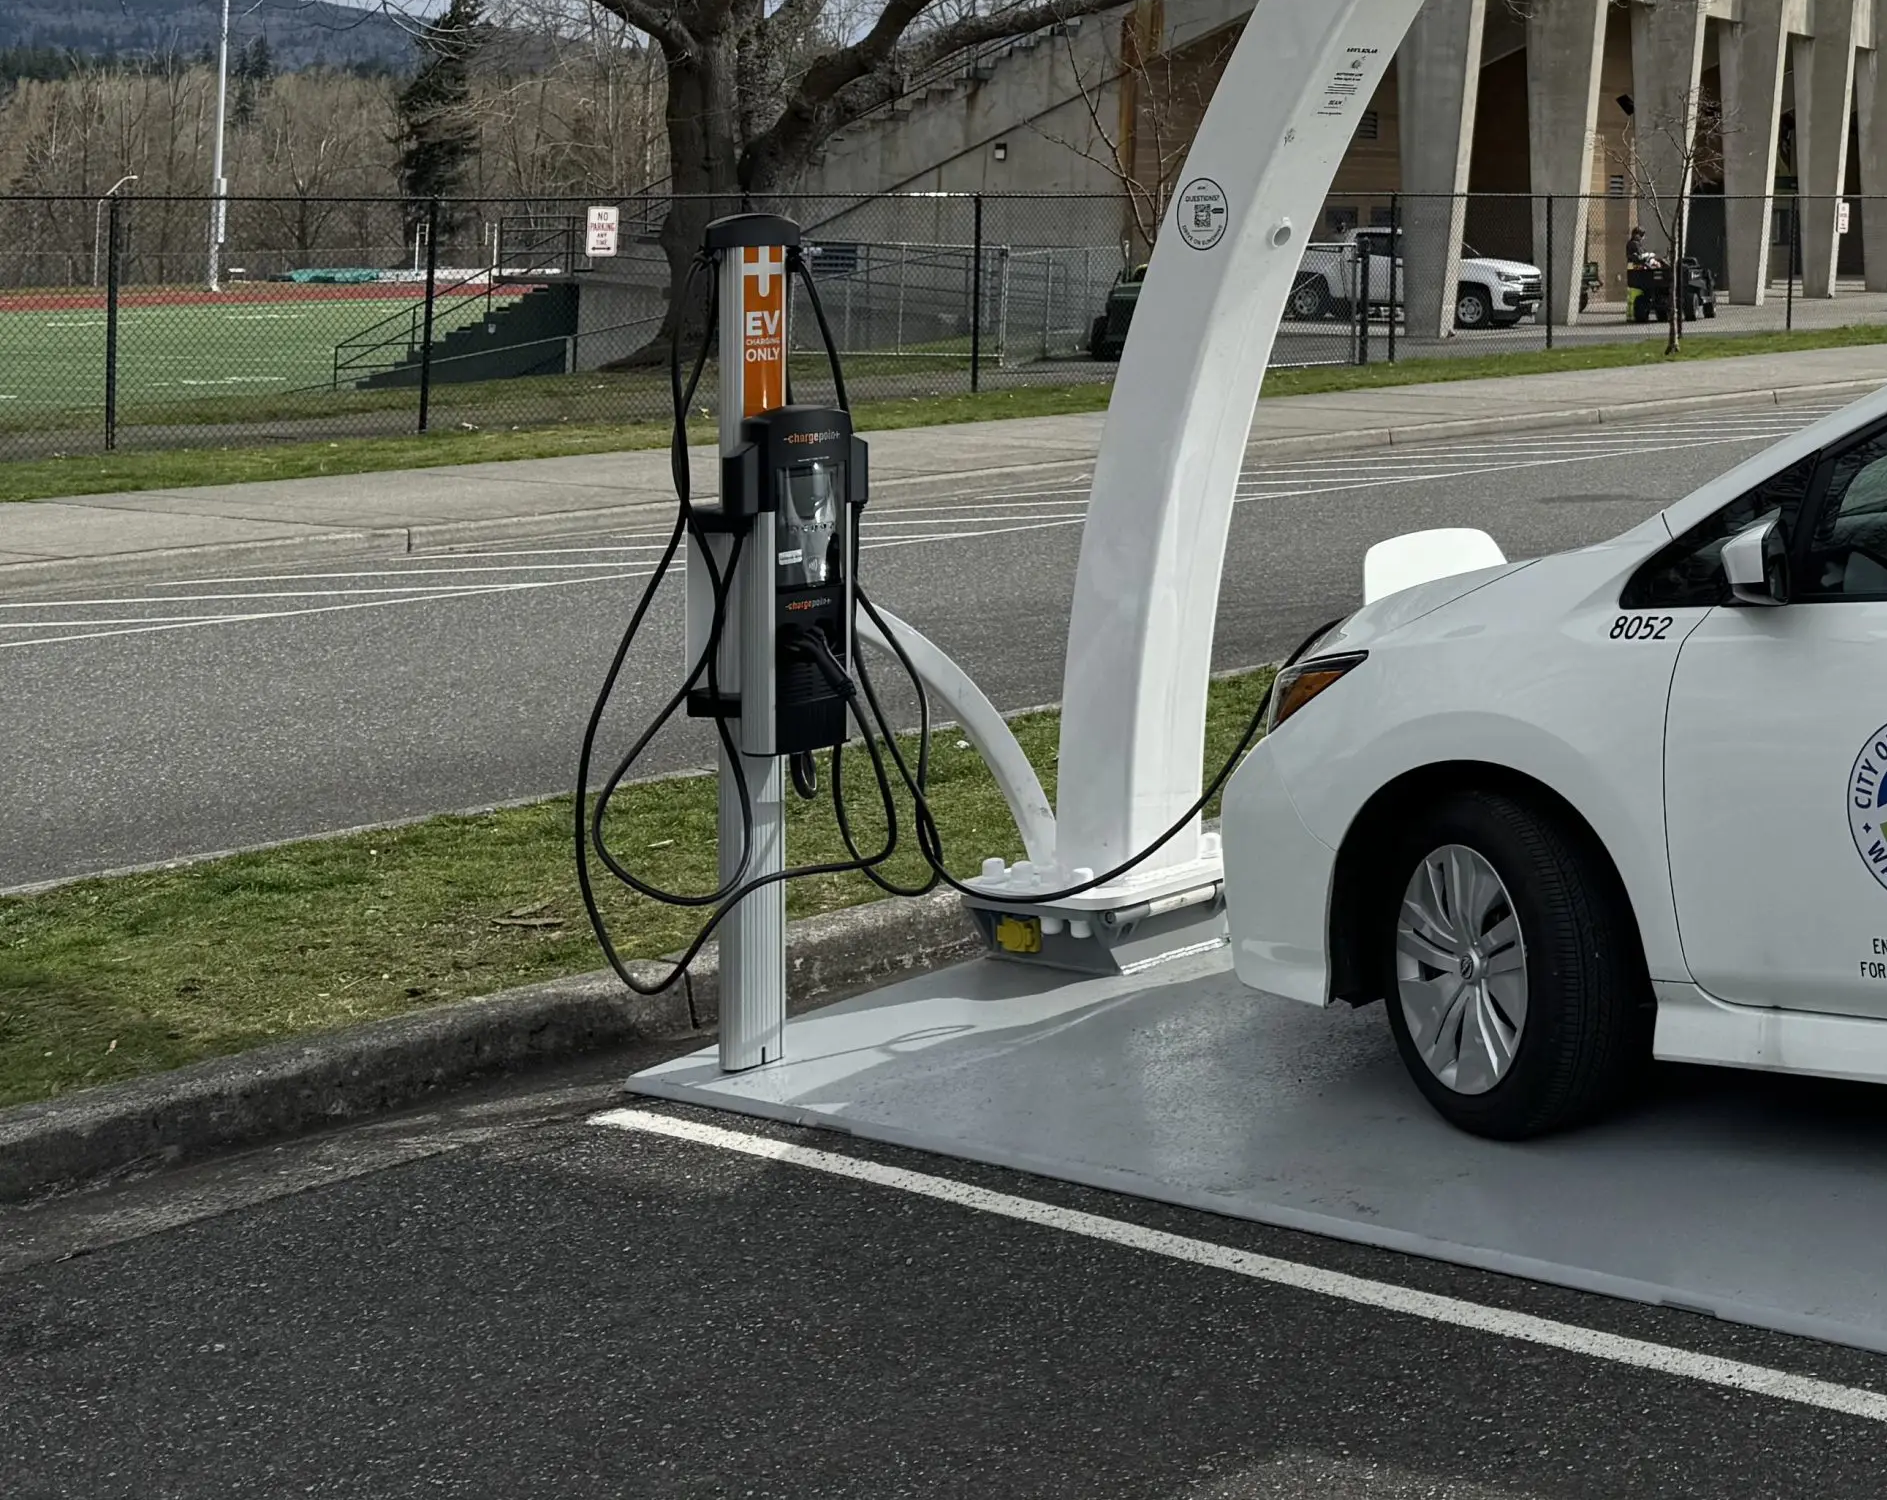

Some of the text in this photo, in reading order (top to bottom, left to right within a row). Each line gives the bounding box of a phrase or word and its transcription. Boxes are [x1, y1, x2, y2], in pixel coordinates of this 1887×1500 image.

[1184, 195, 1220, 203] QUESTIONS?
[597, 212, 609, 221] NO
[590, 222, 616, 232] PARKING
[746, 310, 780, 337] EV
[746, 337, 780, 346] CHARGING
[746, 347, 780, 362] ONLY
[1609, 615, 1674, 640] 8052
[1854, 758, 1879, 810] CITY
[1860, 961, 1886, 979] FOR
